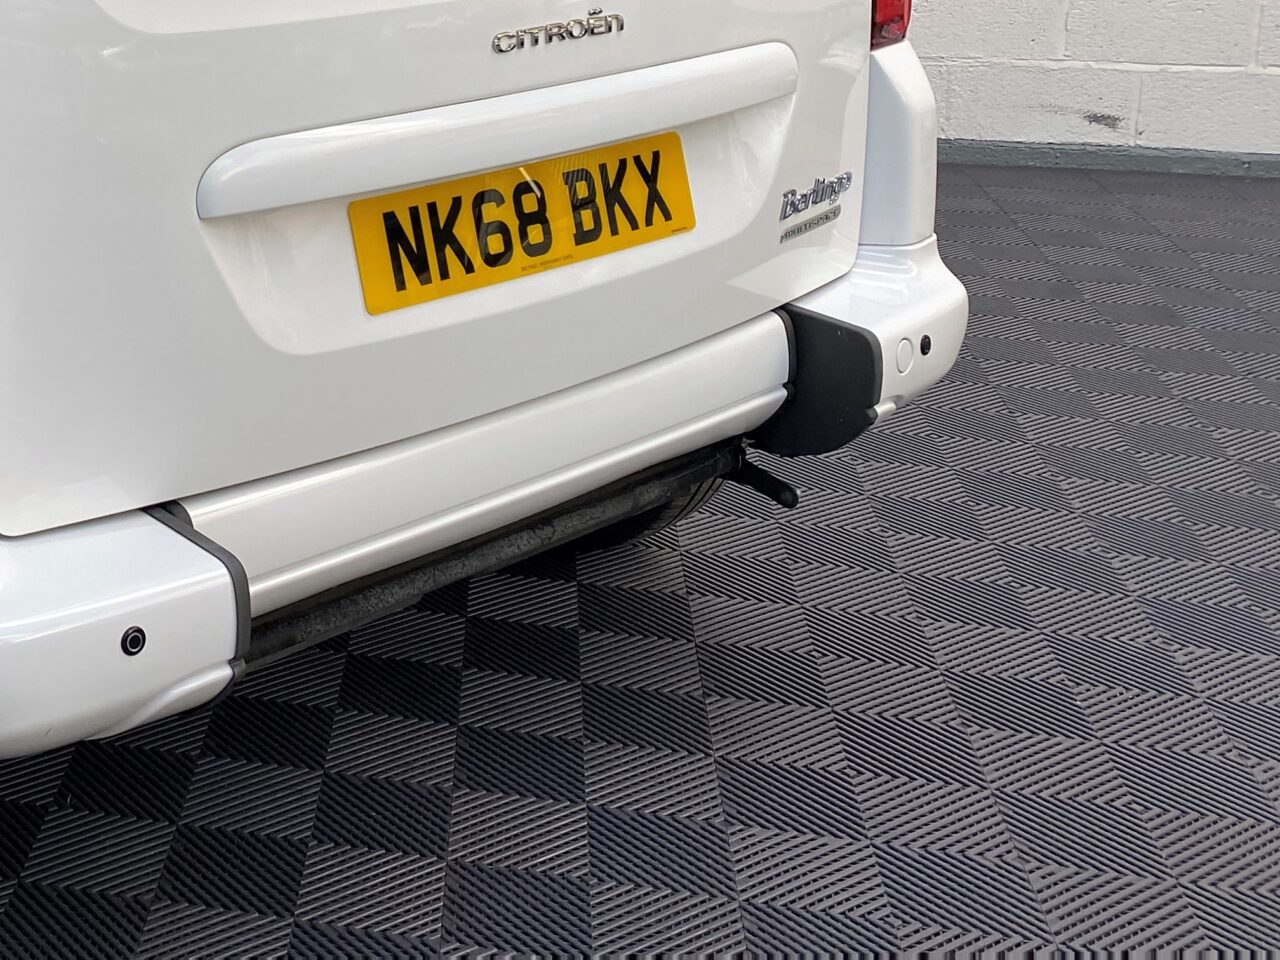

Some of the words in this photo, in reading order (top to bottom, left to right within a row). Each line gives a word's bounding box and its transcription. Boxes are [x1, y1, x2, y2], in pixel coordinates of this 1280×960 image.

[382, 179, 552, 292] NK68
[562, 150, 673, 247] BKX
[779, 171, 852, 222] Berlingo
